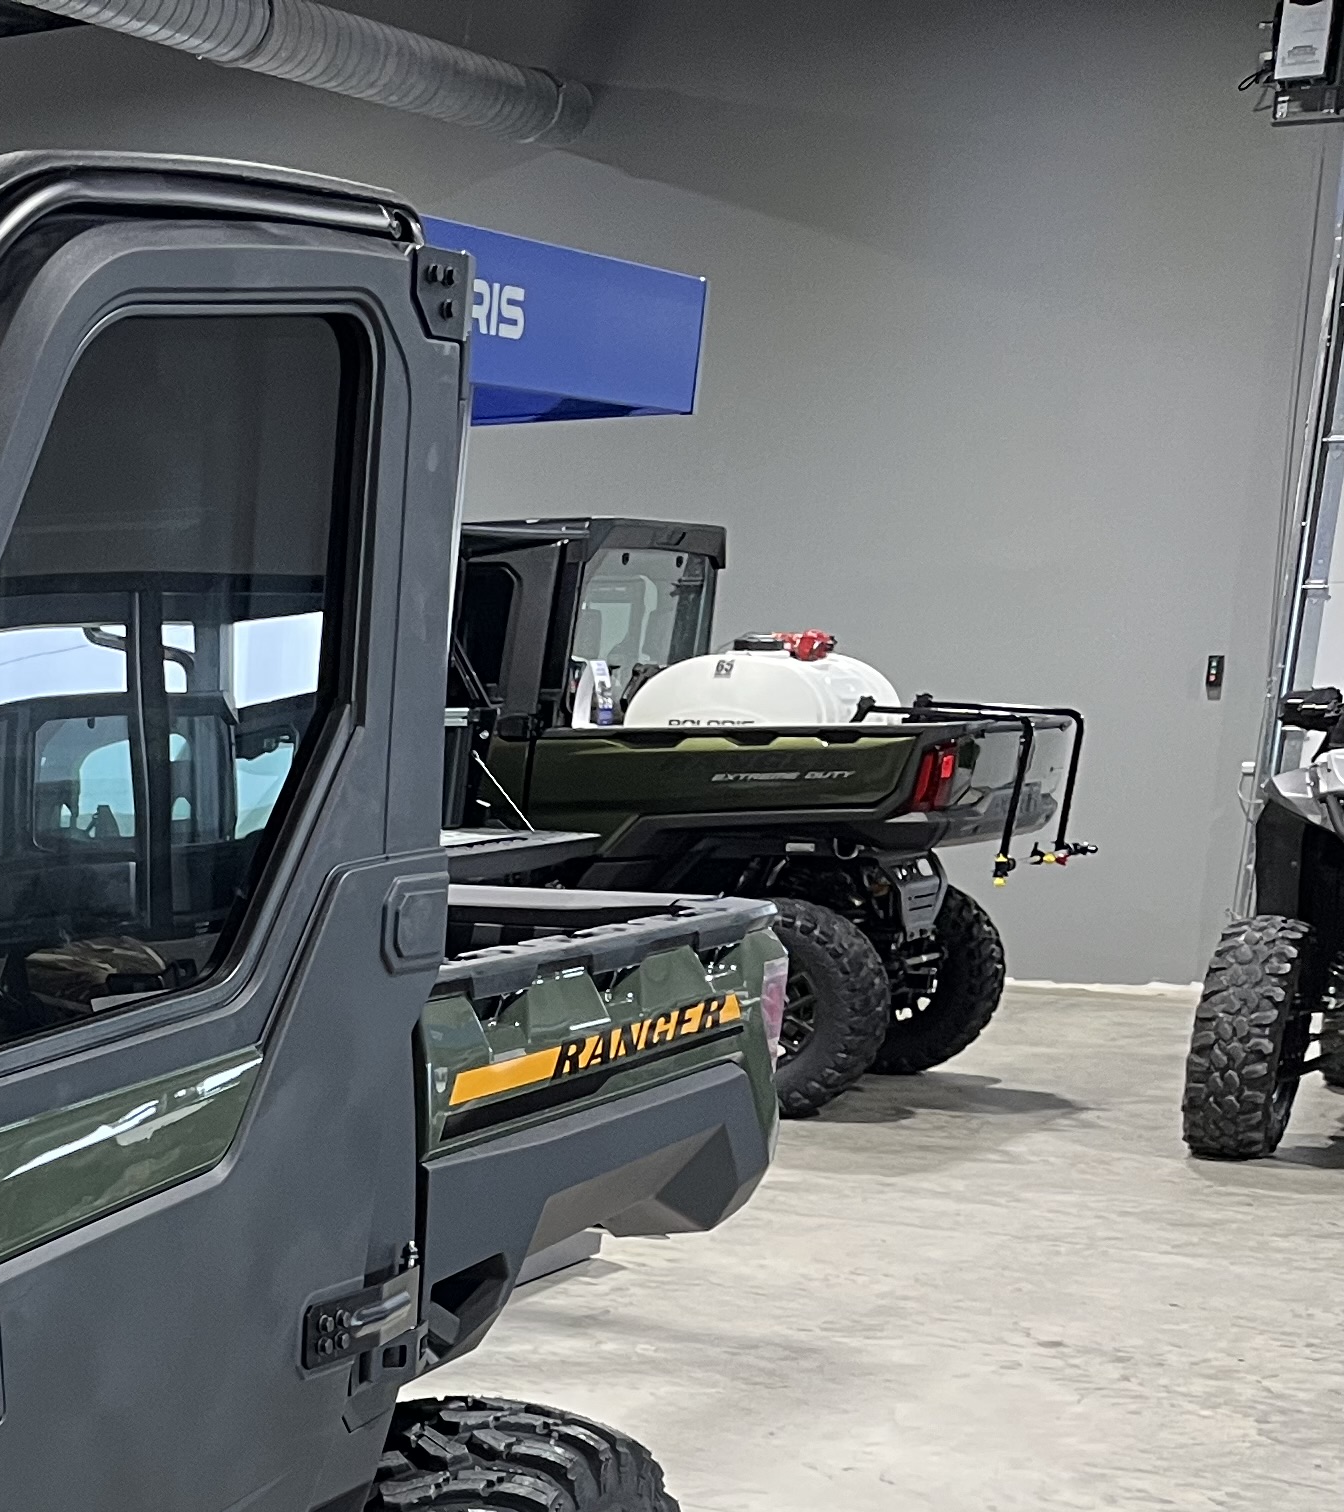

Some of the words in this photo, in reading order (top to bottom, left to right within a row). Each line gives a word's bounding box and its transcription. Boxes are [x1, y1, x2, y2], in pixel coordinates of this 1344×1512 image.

[472, 279, 525, 340] RIS
[712, 772, 800, 782] EXTREME
[805, 770, 856, 780] DUTY
[551, 996, 730, 1080] RANGER
